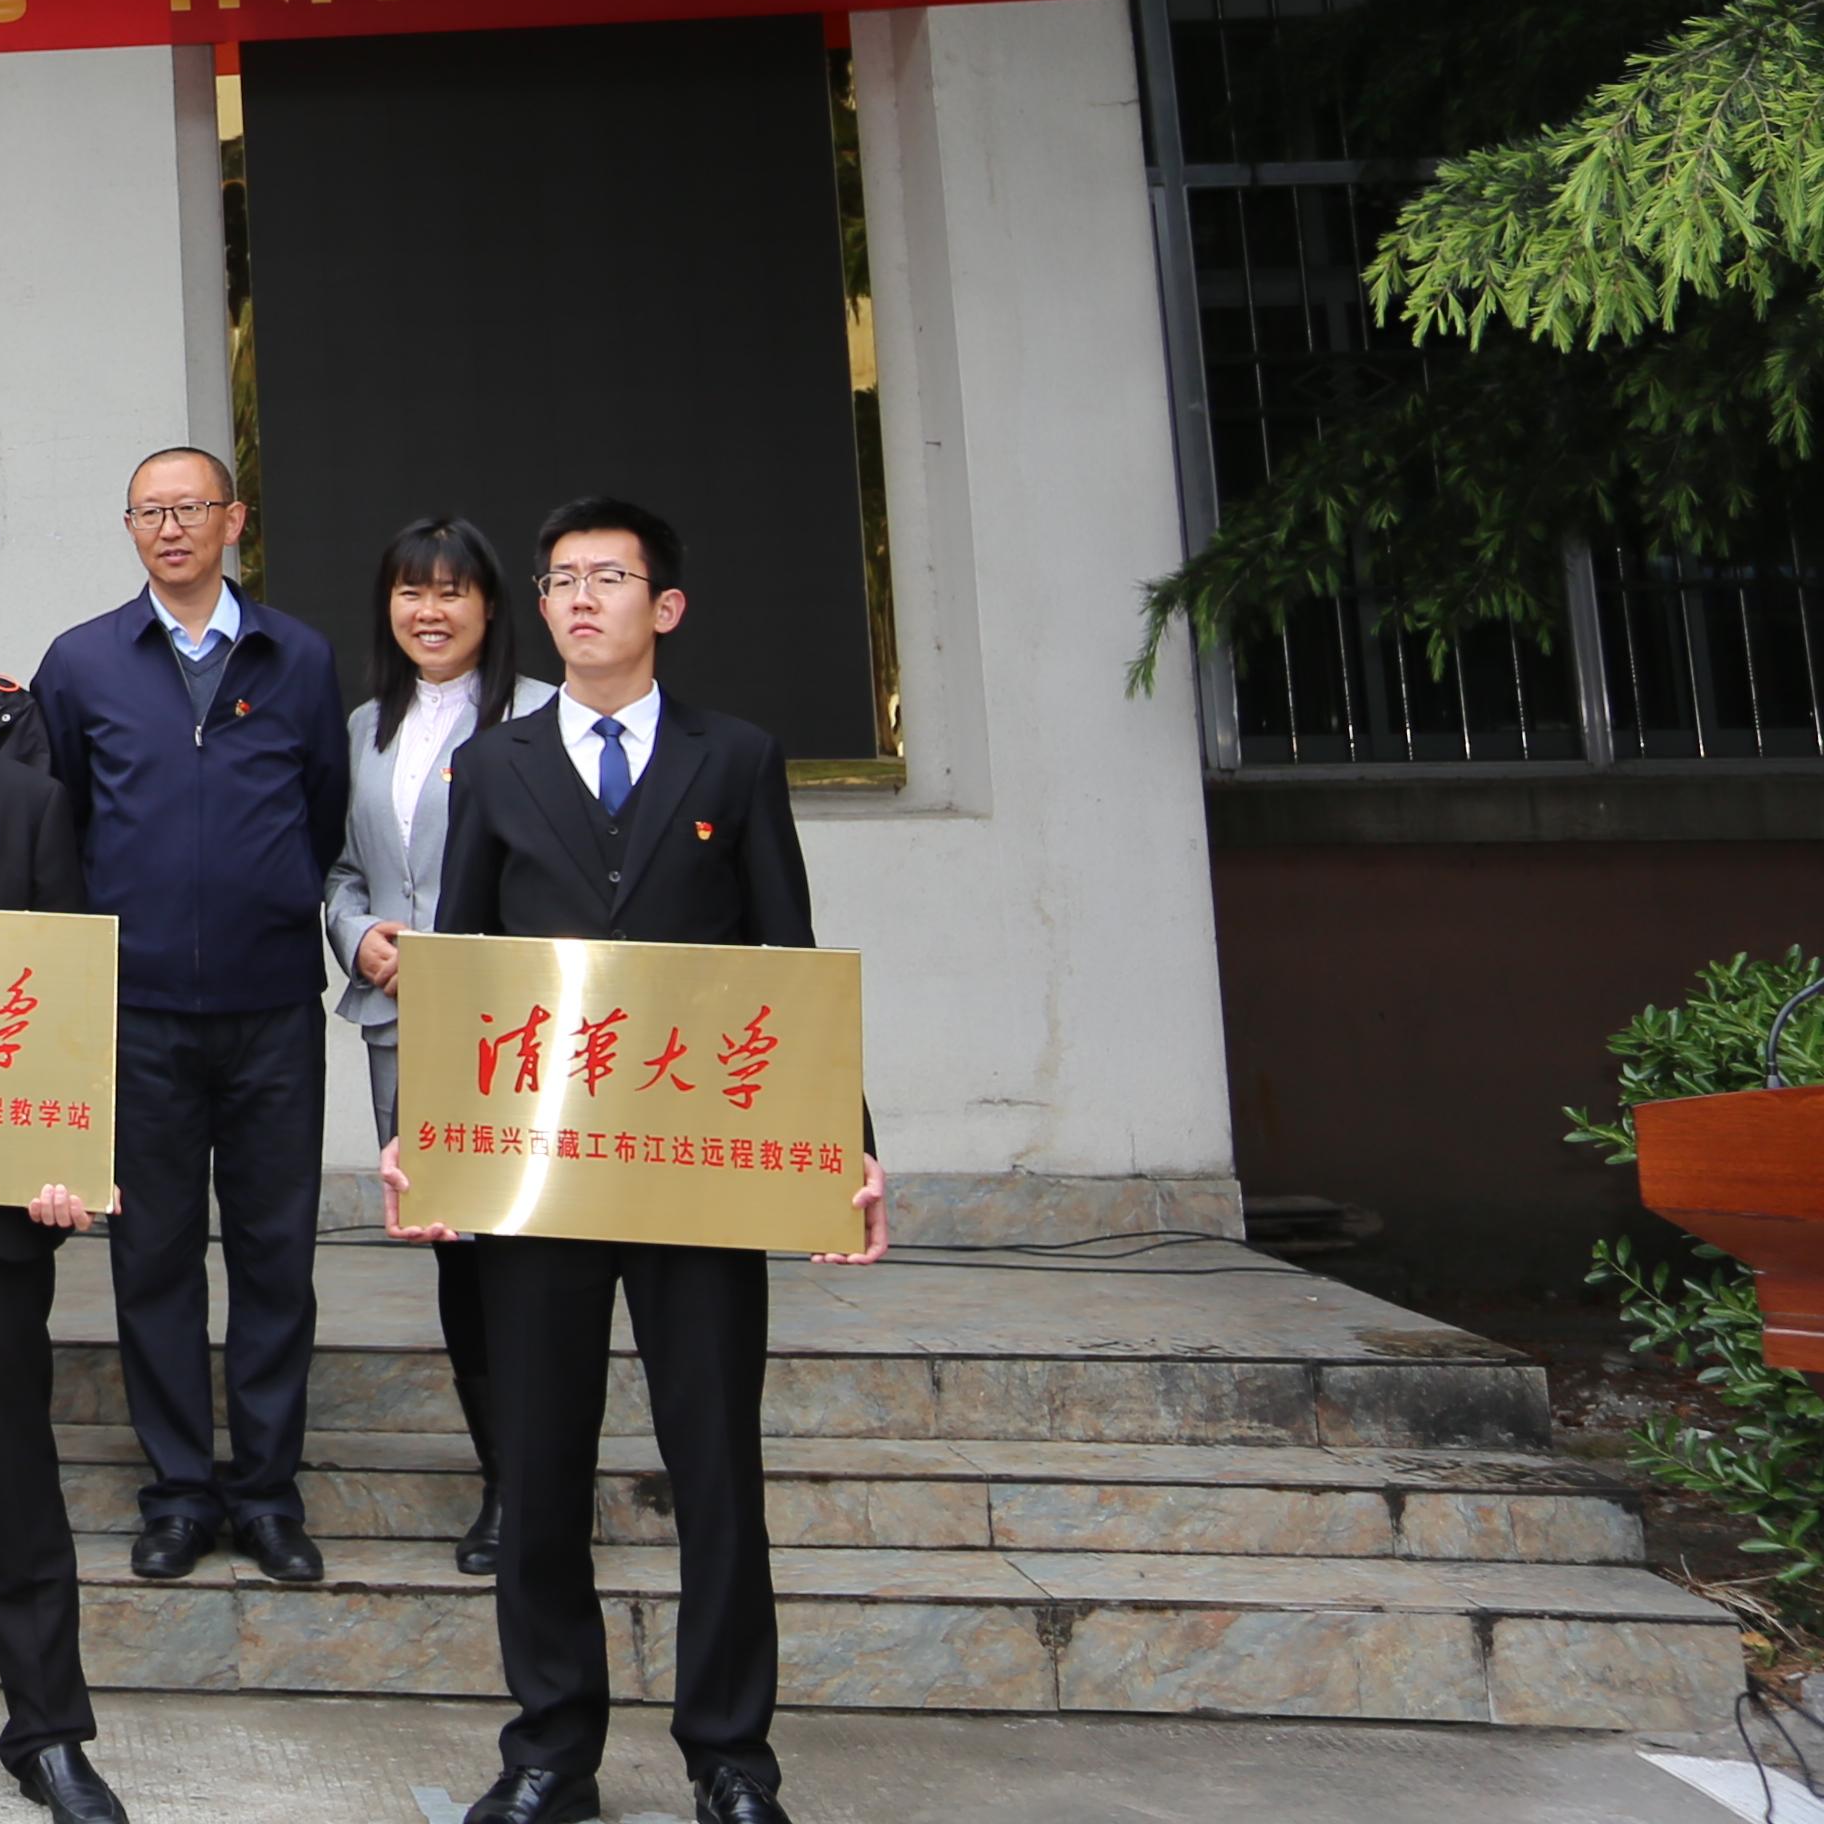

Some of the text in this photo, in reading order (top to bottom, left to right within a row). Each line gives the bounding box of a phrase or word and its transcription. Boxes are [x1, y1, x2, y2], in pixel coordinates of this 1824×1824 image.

[418, 1121, 844, 1175] 乡村振兴西藏工布江达远程教学站
